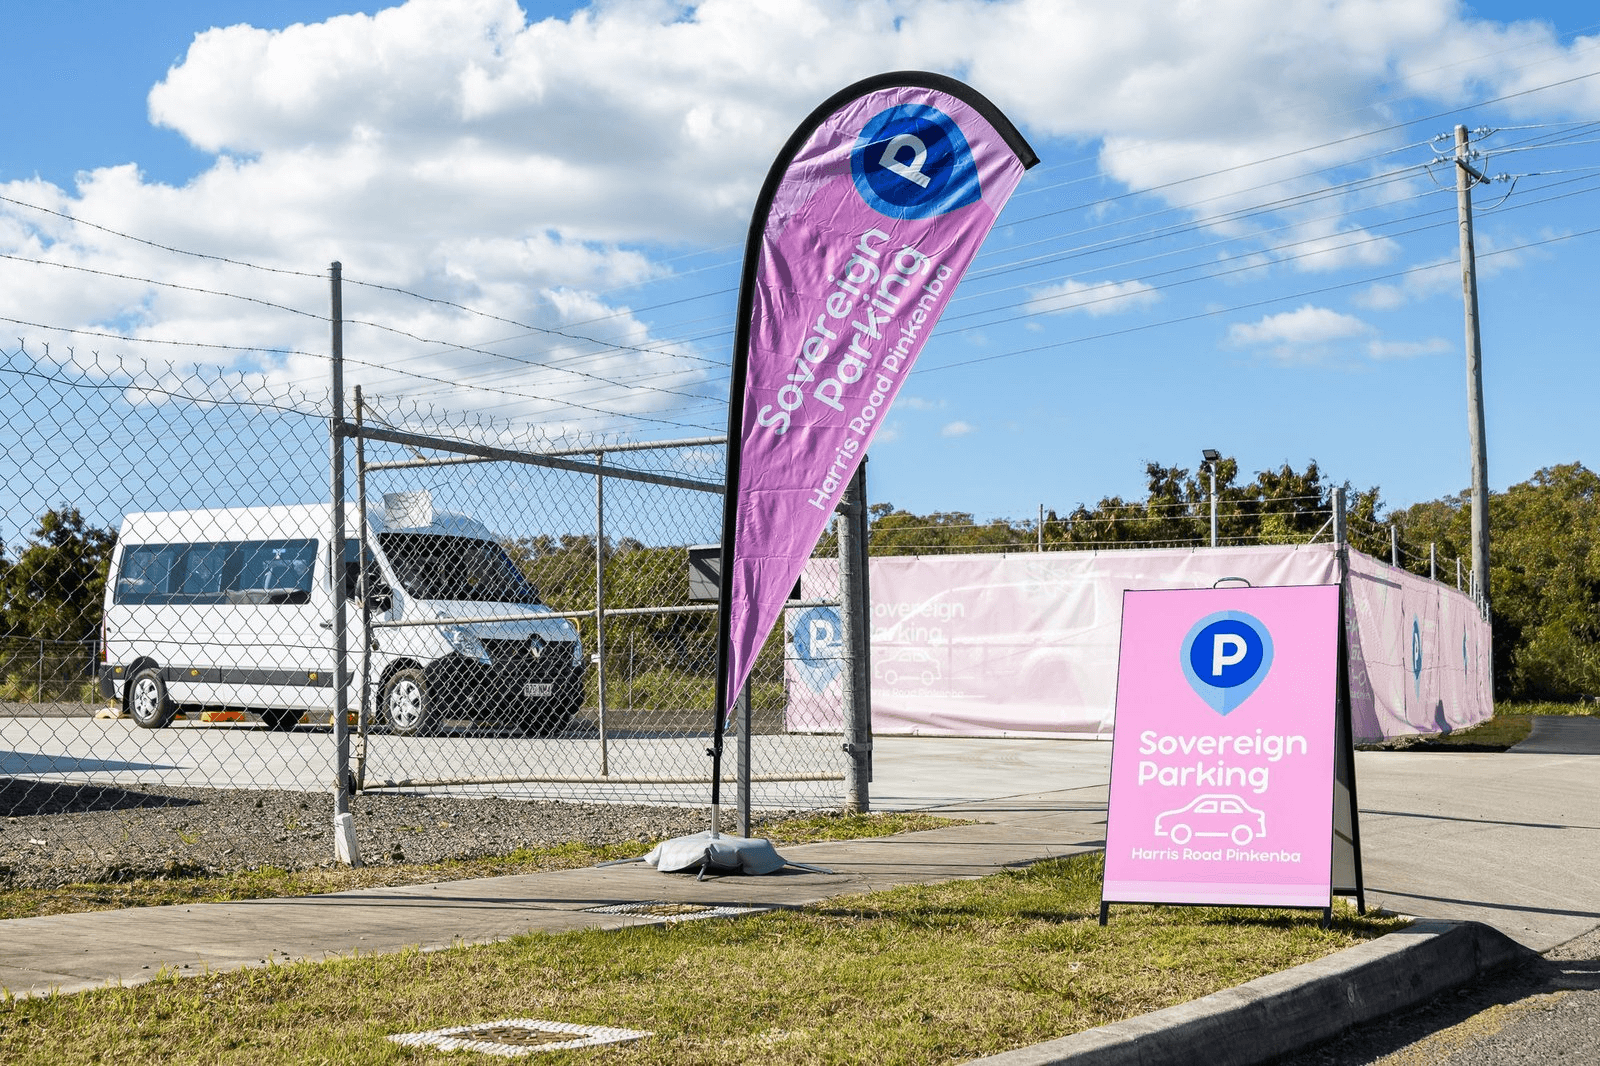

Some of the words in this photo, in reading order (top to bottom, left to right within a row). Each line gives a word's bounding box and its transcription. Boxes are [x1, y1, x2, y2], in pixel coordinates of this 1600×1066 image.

[878, 134, 931, 189] P
[757, 228, 890, 435] Sovereign
[813, 244, 930, 412] Parking
[808, 438, 859, 511] Harris
[850, 373, 894, 436] Road
[882, 263, 953, 374] Pinkenba
[1212, 633, 1248, 676] P
[1138, 728, 1308, 762] Sovereign
[1138, 760, 1270, 794] Parking
[1131, 847, 1179, 861] Harris
[1182, 847, 1223, 862] Road
[1225, 848, 1301, 864] Pinkenba
